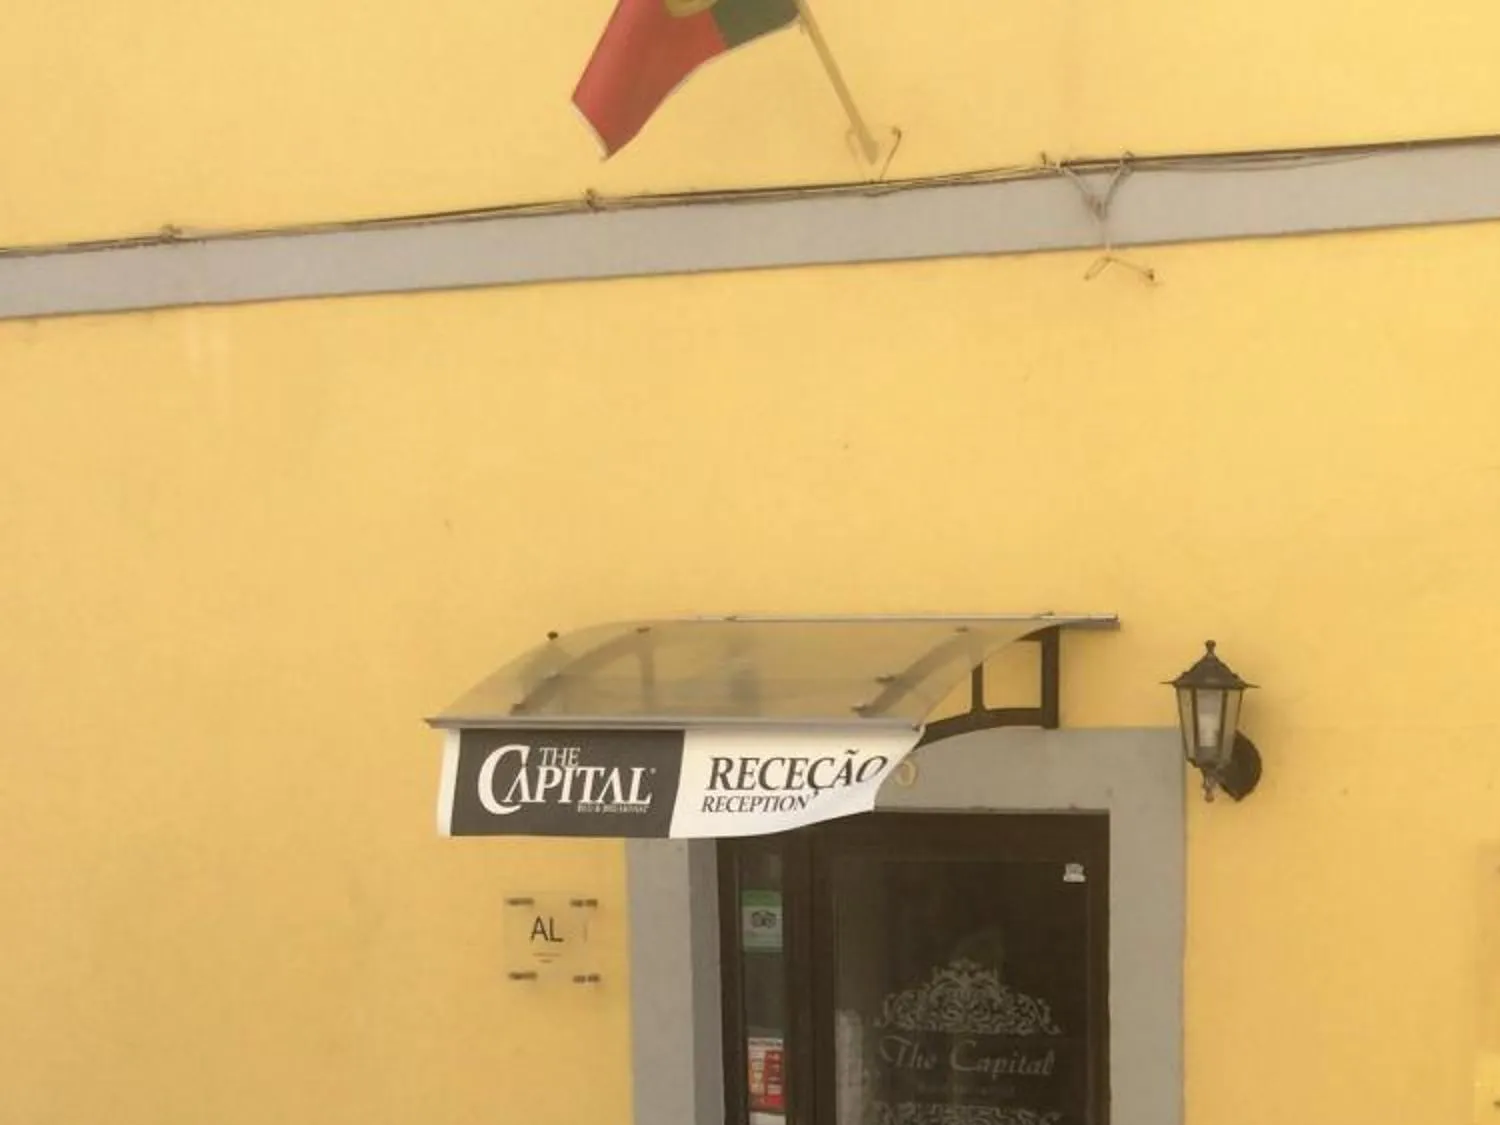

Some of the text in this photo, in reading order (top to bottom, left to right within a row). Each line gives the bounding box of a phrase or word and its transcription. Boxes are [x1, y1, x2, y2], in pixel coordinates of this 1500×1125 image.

[539, 747, 581, 767] THE
[704, 749, 889, 796] RECEÇÃO
[477, 743, 653, 815] CAPITAL
[701, 794, 809, 814] RECEPTION
[529, 915, 565, 942] AL
[879, 1034, 1057, 1082] The Capital
